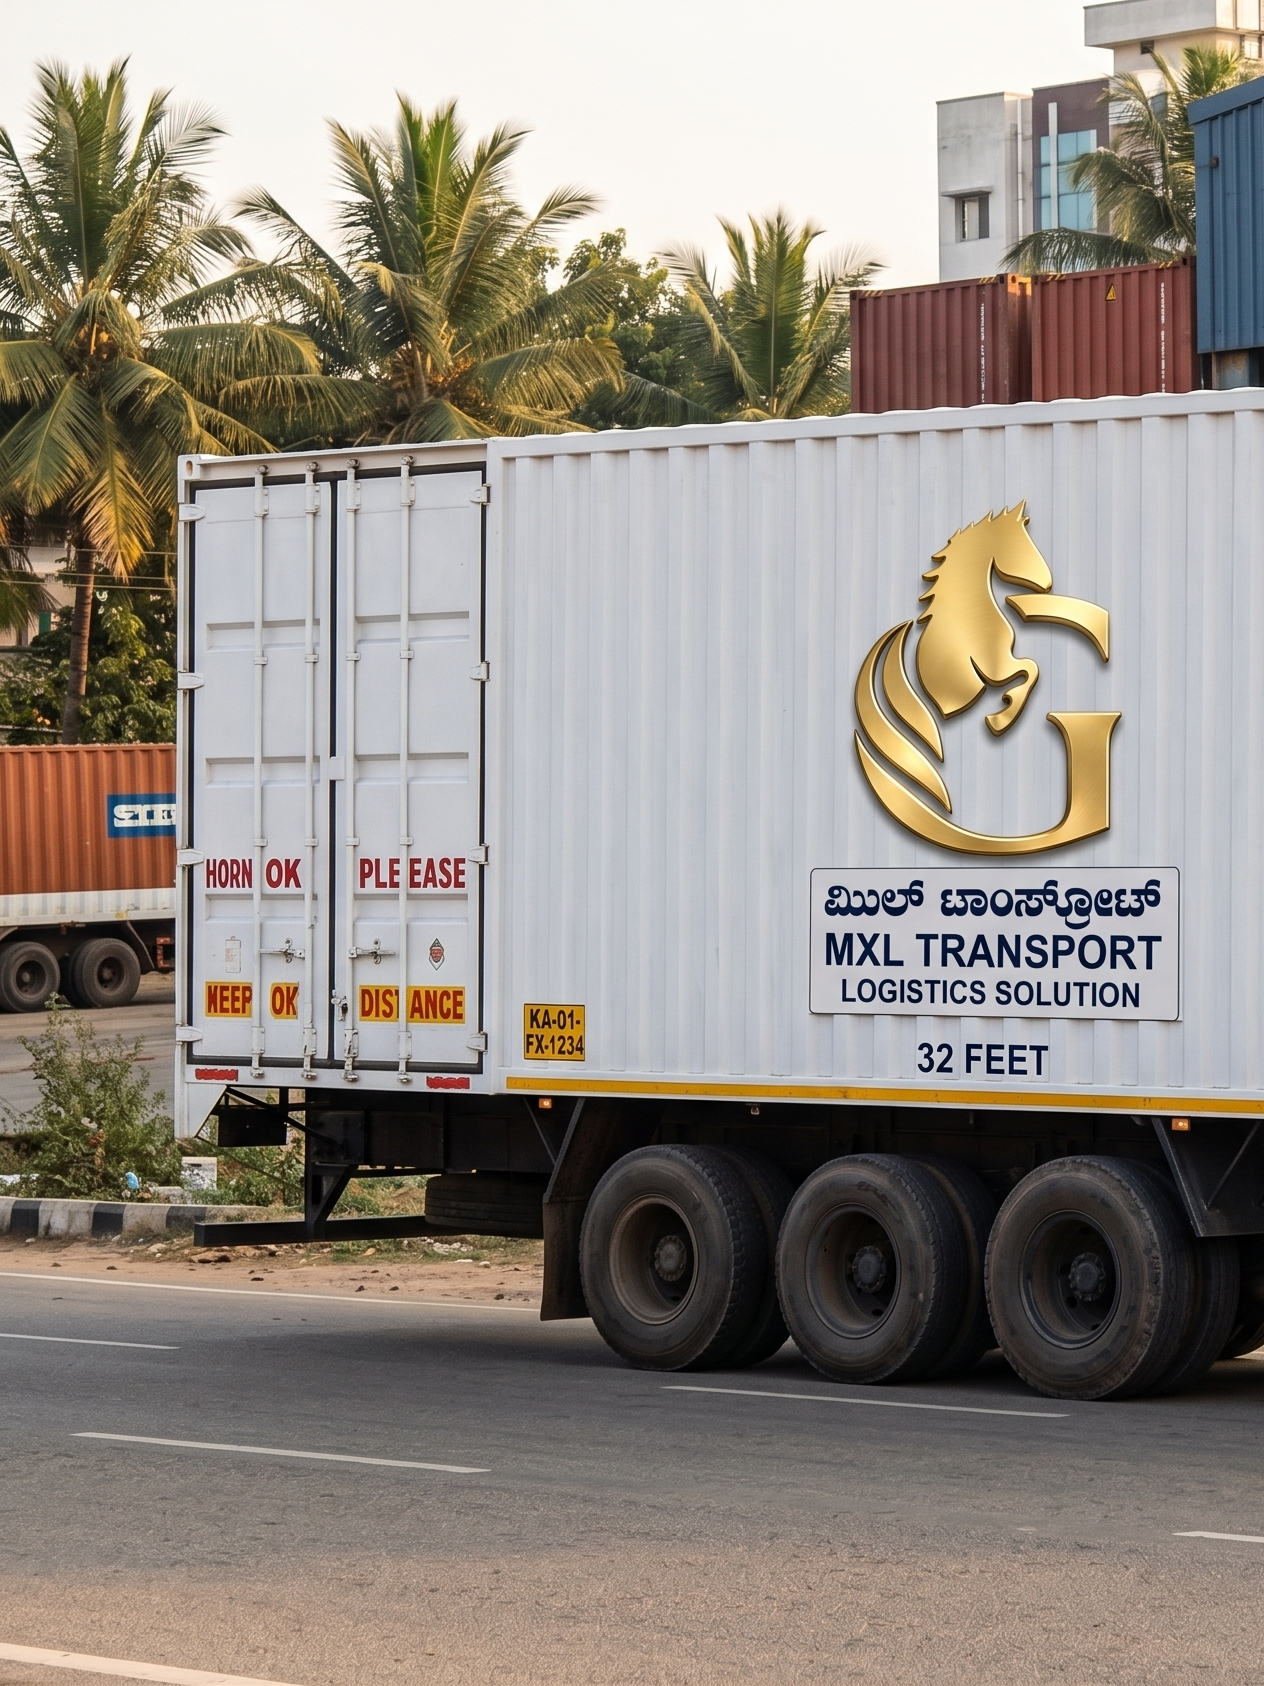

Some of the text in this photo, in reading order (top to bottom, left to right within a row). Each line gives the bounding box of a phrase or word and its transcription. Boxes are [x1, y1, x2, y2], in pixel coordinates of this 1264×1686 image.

[206, 858, 253, 889] HORN
[266, 858, 302, 889] OK
[825, 932, 1162, 970] MXL TRANSPORT
[841, 978, 1140, 1008] LOGISTICS SOLUTION
[529, 1008, 581, 1030] KA-01-
[525, 1033, 584, 1055] FX-1234
[917, 1042, 1049, 1076] 32 FEET
